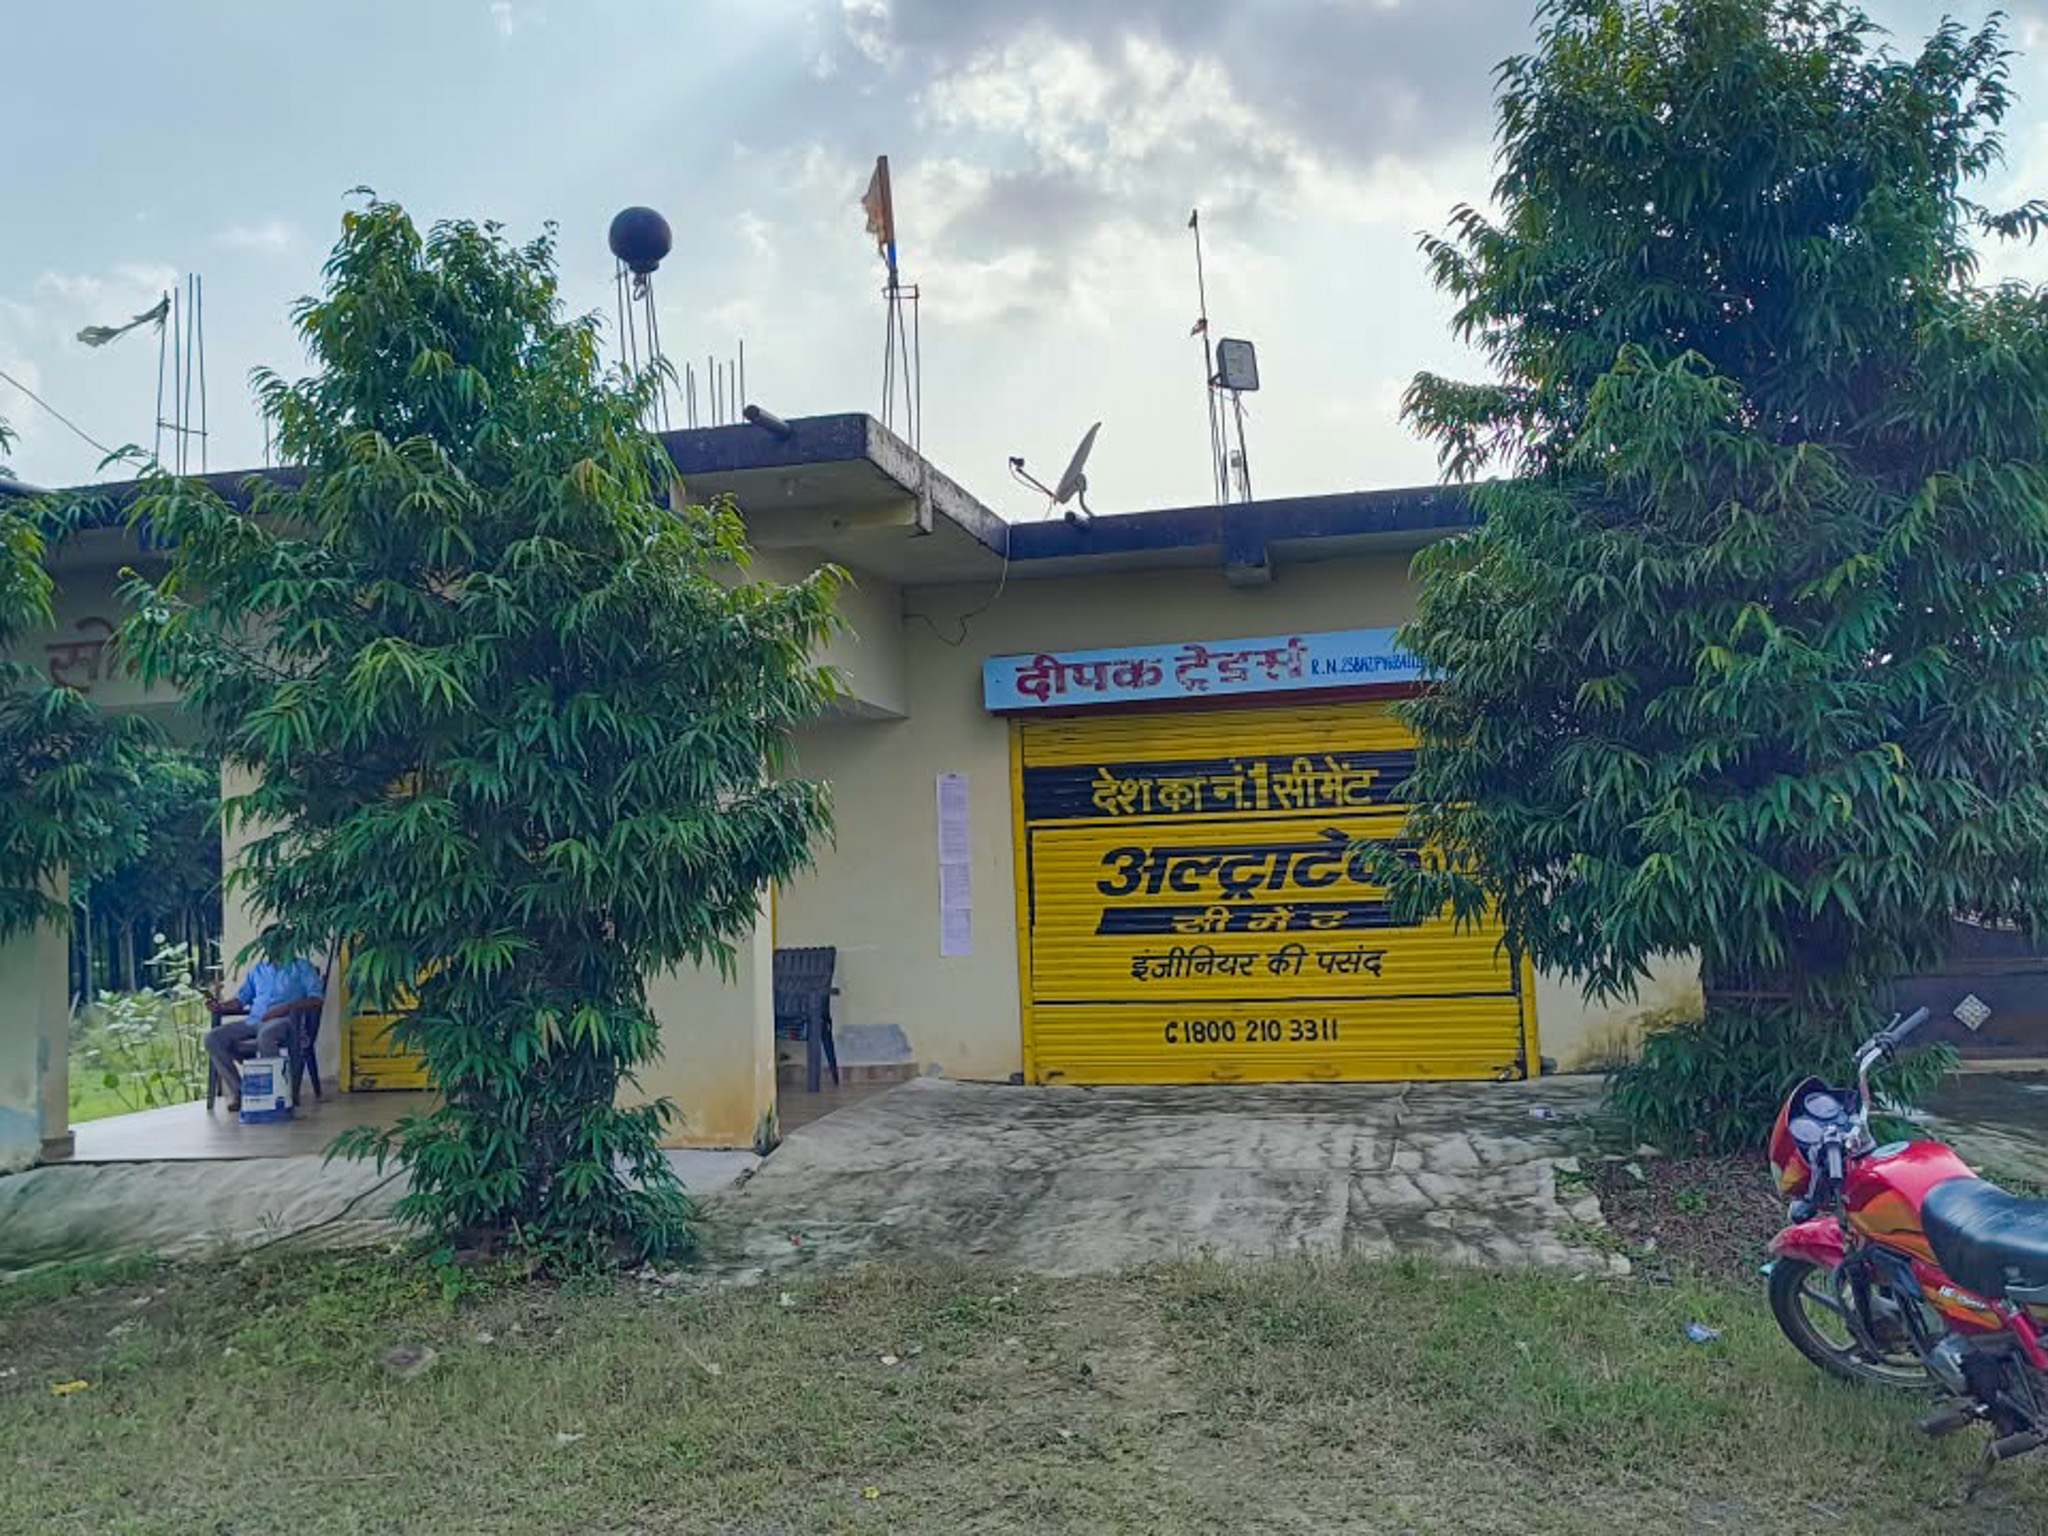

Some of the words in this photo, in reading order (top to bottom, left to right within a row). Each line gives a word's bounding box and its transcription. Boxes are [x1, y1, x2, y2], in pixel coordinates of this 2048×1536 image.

[1015, 653, 1164, 702] दीपक
[1091, 766, 1153, 816] देश
[1156, 776, 1207, 812] का
[1271, 755, 1380, 810] सीमेंट
[1130, 946, 1259, 982] इंजीनियर
[1267, 943, 1310, 976] की
[1316, 945, 1388, 977] पसंद
[1245, 1019, 1282, 1041] 210
[1289, 1017, 1339, 1041] 3311
